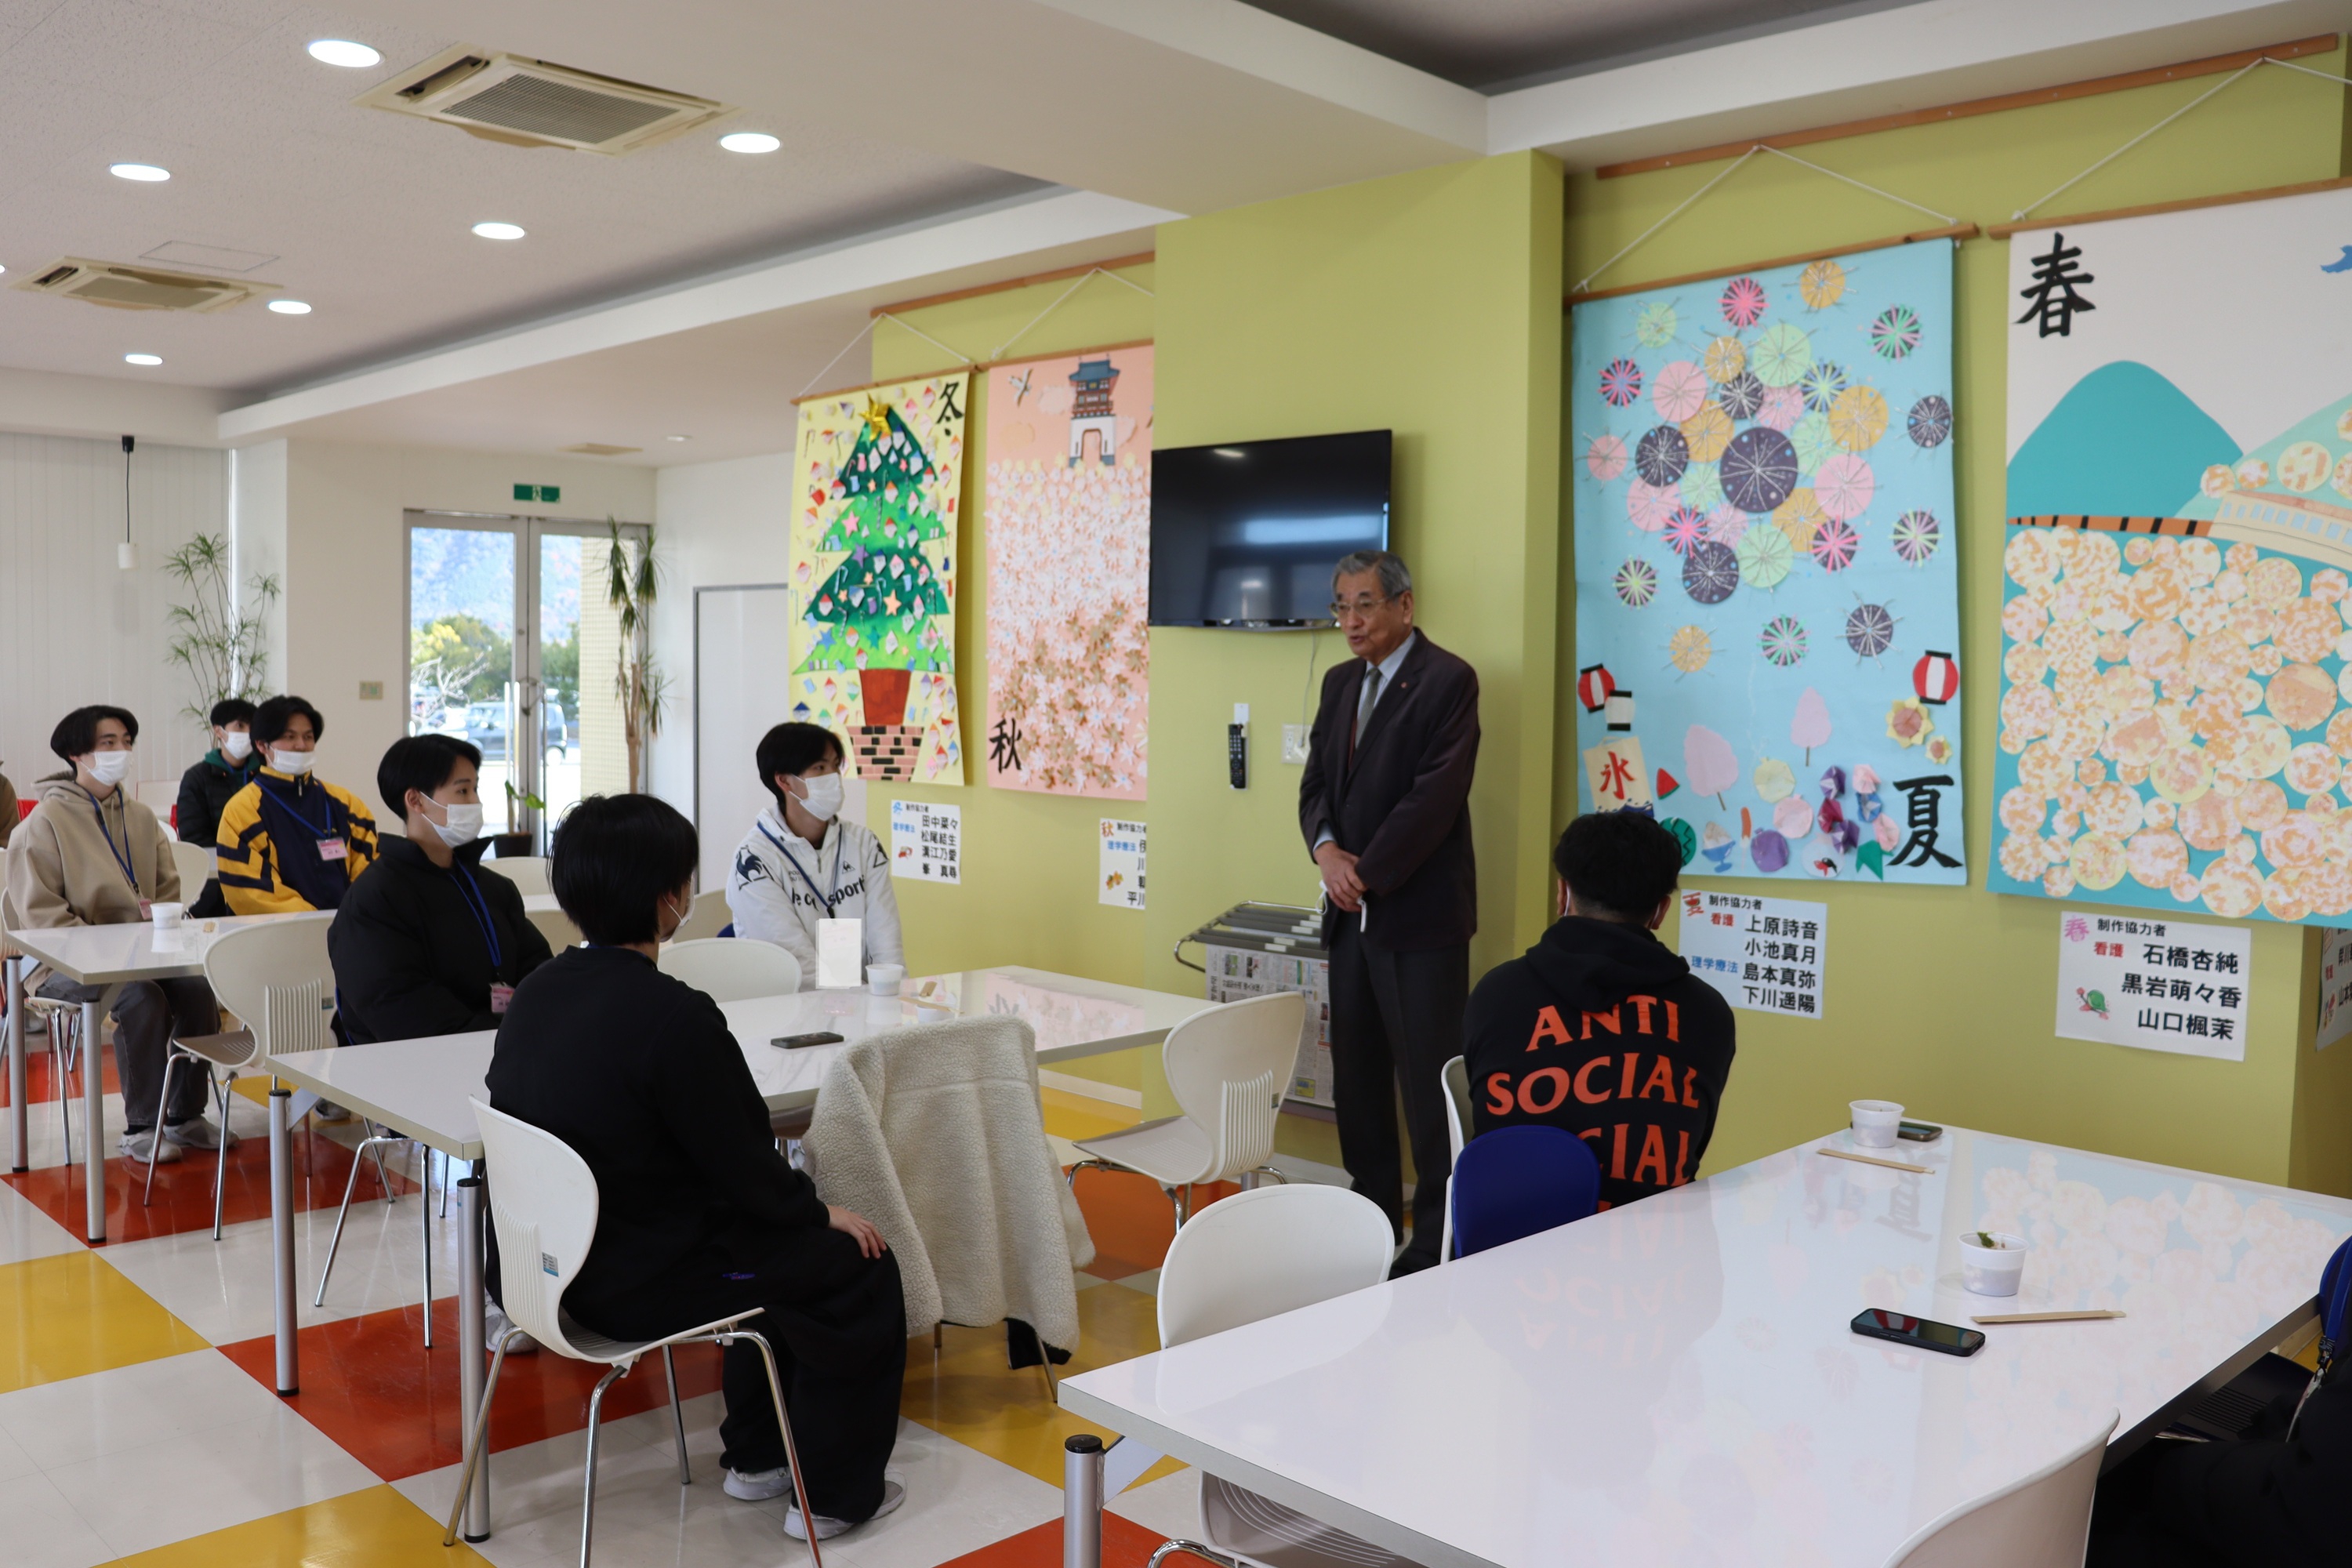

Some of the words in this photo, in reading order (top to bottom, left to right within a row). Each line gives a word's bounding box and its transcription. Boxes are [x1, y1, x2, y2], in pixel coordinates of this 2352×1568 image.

[2012, 232, 2096, 339] 春
[936, 381, 964, 437] 冬
[989, 717, 1022, 775] 秋
[1599, 750, 1635, 800] 氷
[1101, 821, 1114, 837] 秋
[1886, 775, 1963, 869] 夏
[1708, 895, 1762, 910] 制作協力者
[1744, 914, 1818, 940] 上原詩音
[2097, 918, 2166, 937] 制作協力者
[1691, 955, 1738, 974] 理学療法
[1744, 938, 1816, 965] 小池真月
[2094, 941, 2124, 958] 看護
[2143, 943, 2238, 975] 石橋杏純
[1743, 962, 1816, 989] 島本真弥
[2122, 972, 2242, 1008] 黒岩萌々香
[1526, 995, 1679, 1052] ANTI
[2138, 1008, 2234, 1040] 山口楓茉
[1486, 1052, 1699, 1116] SOCIAL
[1577, 1123, 1690, 1186] IAL
